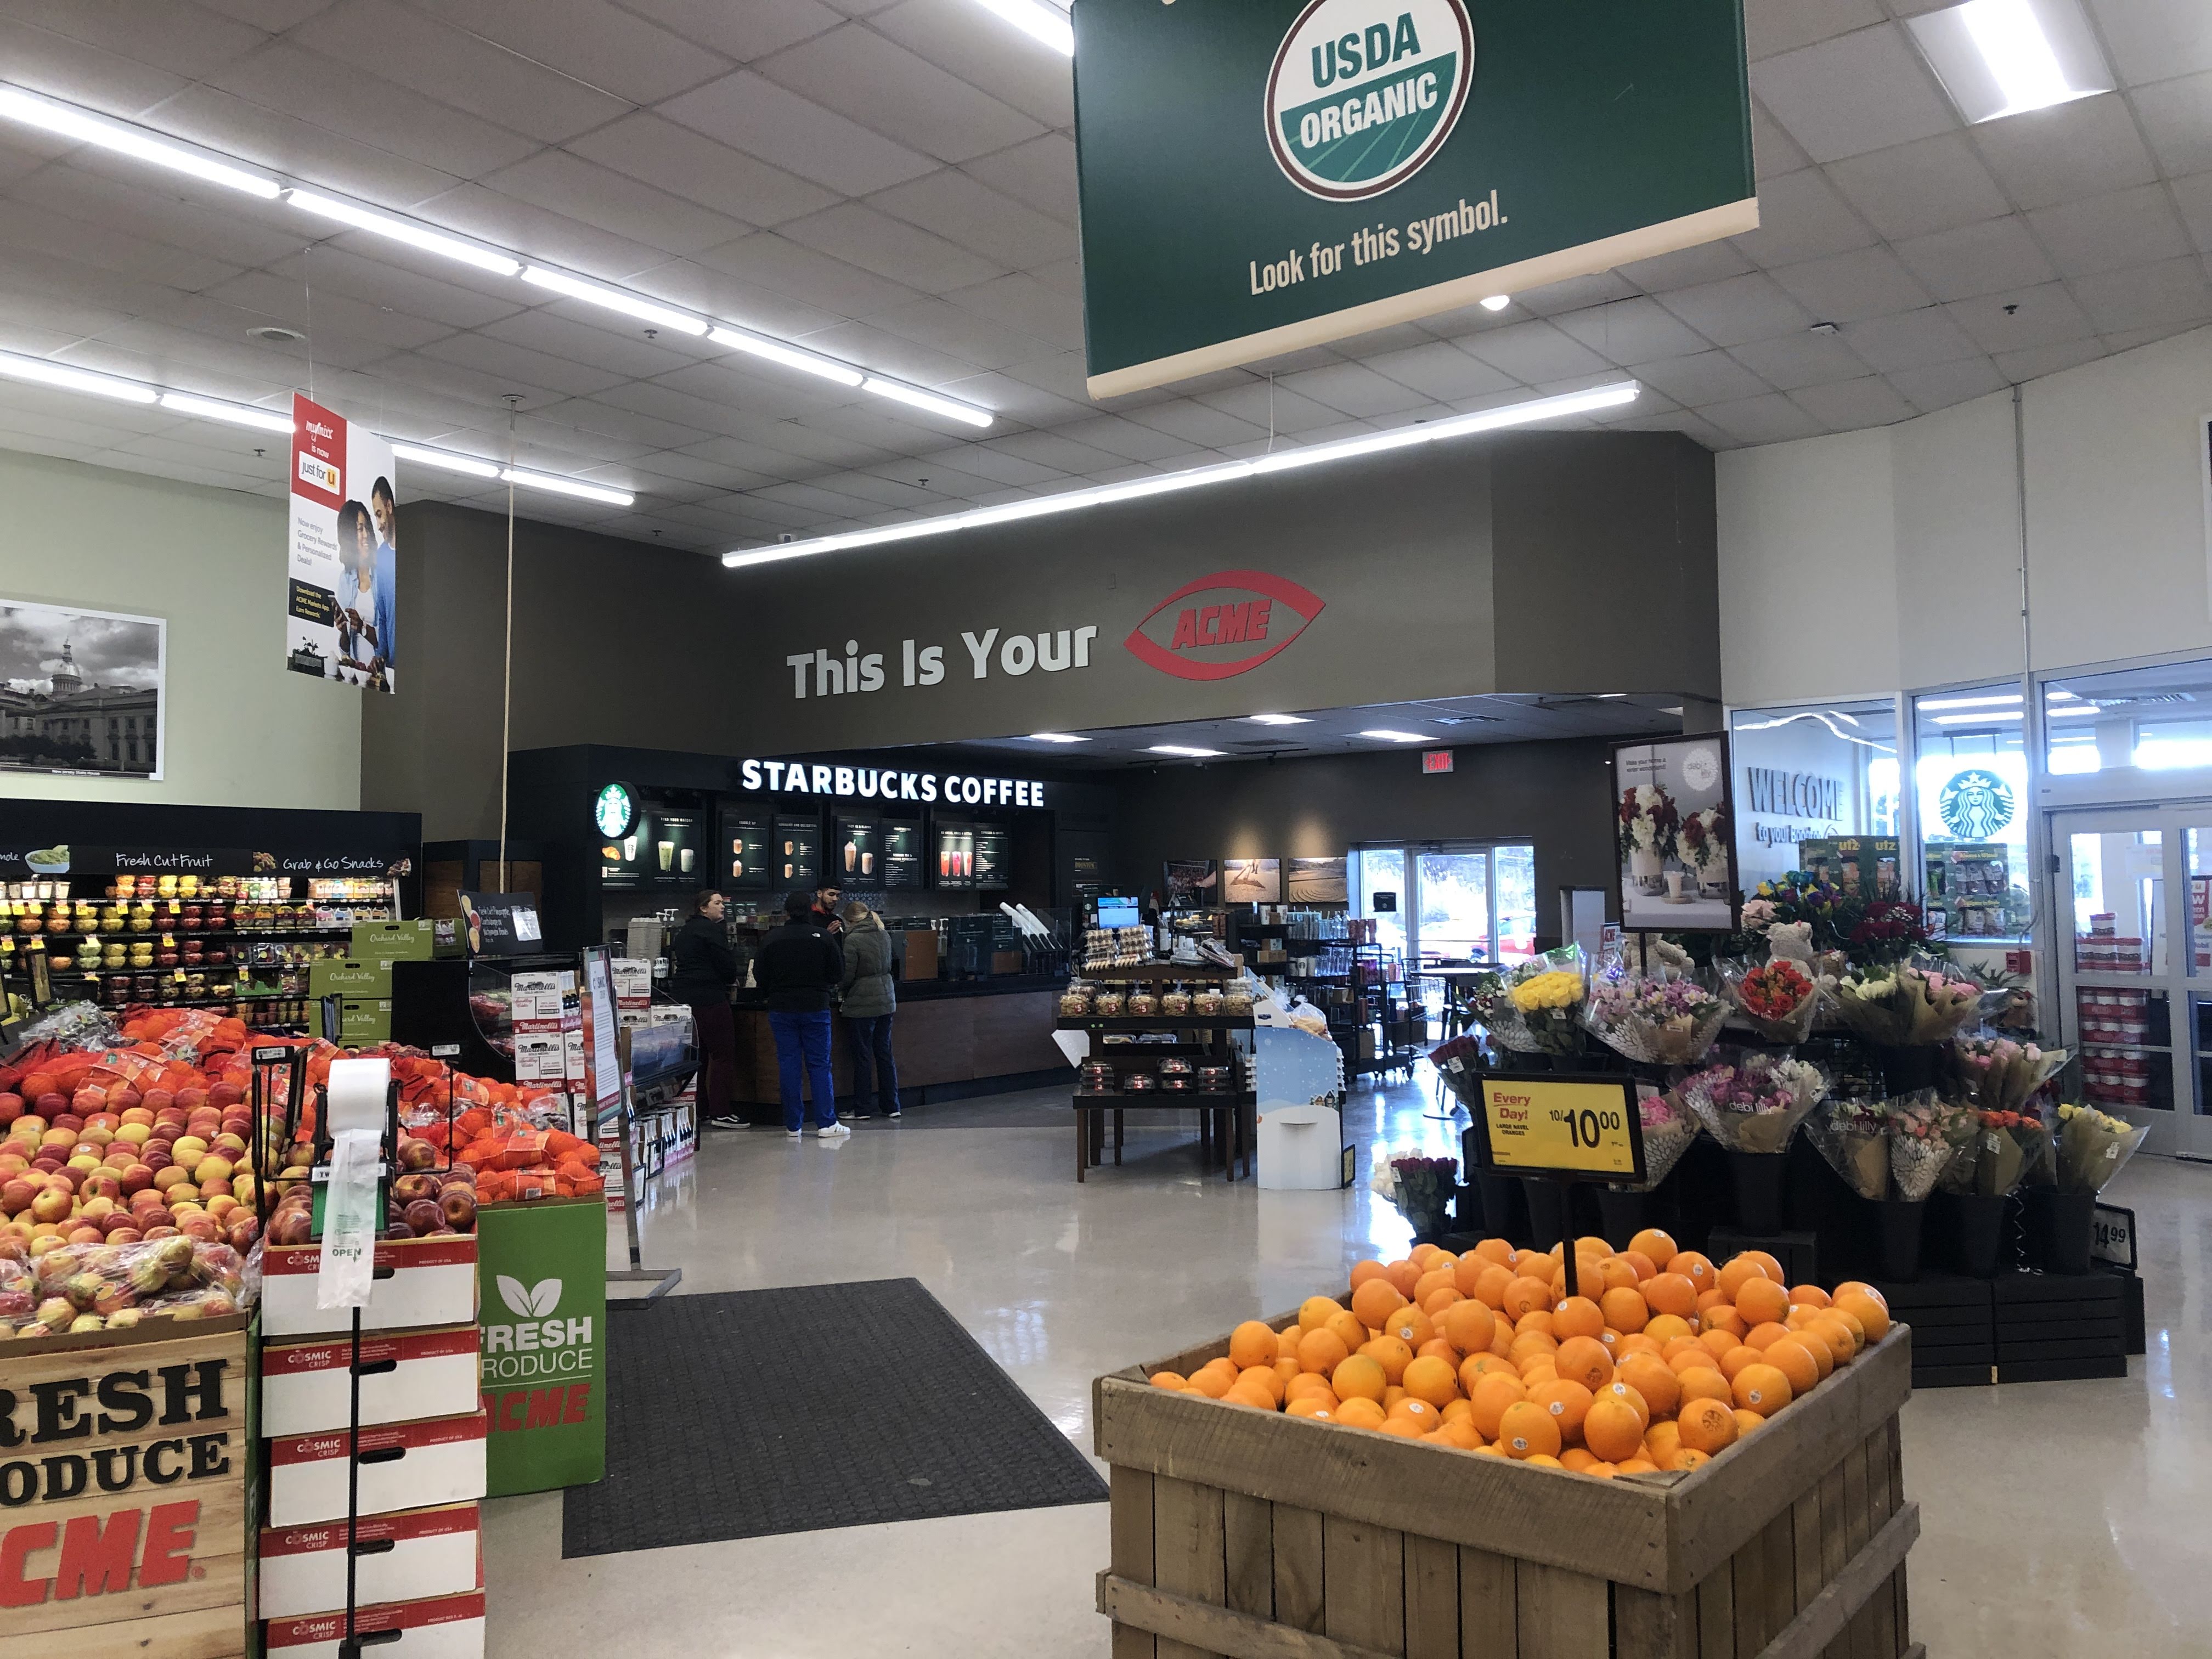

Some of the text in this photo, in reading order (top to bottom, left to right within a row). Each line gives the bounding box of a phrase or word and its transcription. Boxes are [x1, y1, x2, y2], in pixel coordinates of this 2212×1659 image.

[1312, 13, 1421, 89] USDA
[1301, 71, 1438, 149] ORGANIC
[1250, 189, 1509, 296] Look for this symbol.
[311, 443, 329, 459] is now
[302, 462, 335, 485] just for u
[297, 517, 323, 535] Now enjoy
[297, 530, 317, 544] Grocery
[302, 543, 332, 561] Personalized
[297, 555, 312, 566] Deals!
[787, 599, 1273, 698] This Is Your ACME
[1427, 753, 1448, 770] EXIT
[743, 759, 1044, 807] STARBUCKS COFFEE
[1748, 767, 1843, 821] WELCOME
[1839, 838, 1860, 851] utz
[1876, 840, 1896, 851] utz
[116, 853, 213, 867] Fresh Cut Fruit
[283, 858, 312, 870] Grab
[324, 857, 338, 870] Go
[341, 856, 383, 870] Snacks
[370, 933, 415, 943] Orchard Valley
[330, 972, 375, 982] Orchard Valley
[357, 1014, 376, 1024] Valley
[1493, 1092, 1531, 1107] Every
[1500, 1108, 1528, 1121] Day!
[1729, 1101, 1772, 1114] debi lilly
[1830, 1120, 1876, 1133] debi lilly
[287, 1252, 319, 1266] COSM
[332, 1248, 362, 1257] OPEN
[288, 1350, 331, 1364] COSMIC
[481, 1348, 592, 1379] RODUCE
[297, 1439, 340, 1453] COSMIC
[318, 1448, 339, 1457] CRISP
[0, 1432, 229, 1506] ODUCE
[285, 1531, 329, 1545] COSMIC
[306, 1540, 327, 1549] CRISP
[0, 1499, 199, 1607] CME
[292, 1621, 336, 1635] COSMIC
[313, 1630, 334, 1639] CRISP
